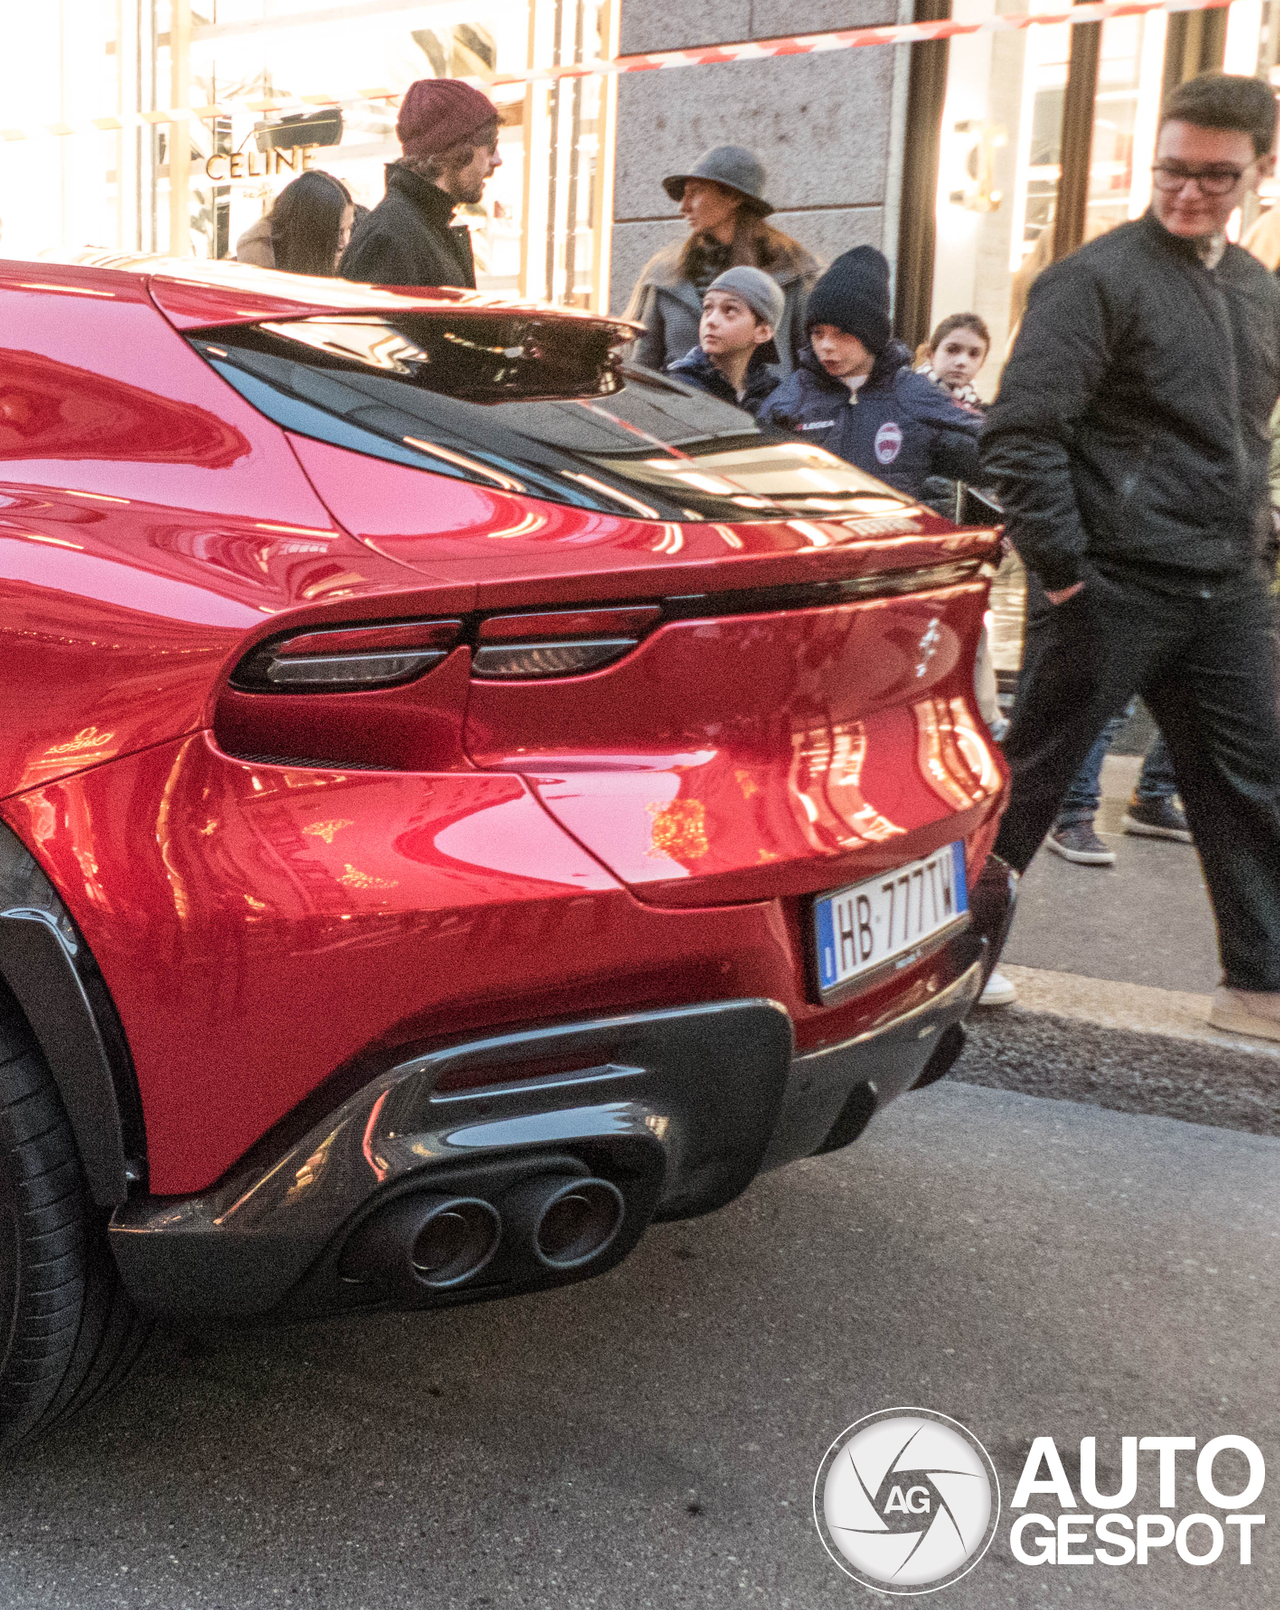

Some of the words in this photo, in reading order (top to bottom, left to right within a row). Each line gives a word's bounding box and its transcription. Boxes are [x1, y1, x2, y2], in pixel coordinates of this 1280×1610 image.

[205, 142, 319, 180] CELINE
[837, 893, 874, 971] HB
[881, 852, 953, 949] 777TW
